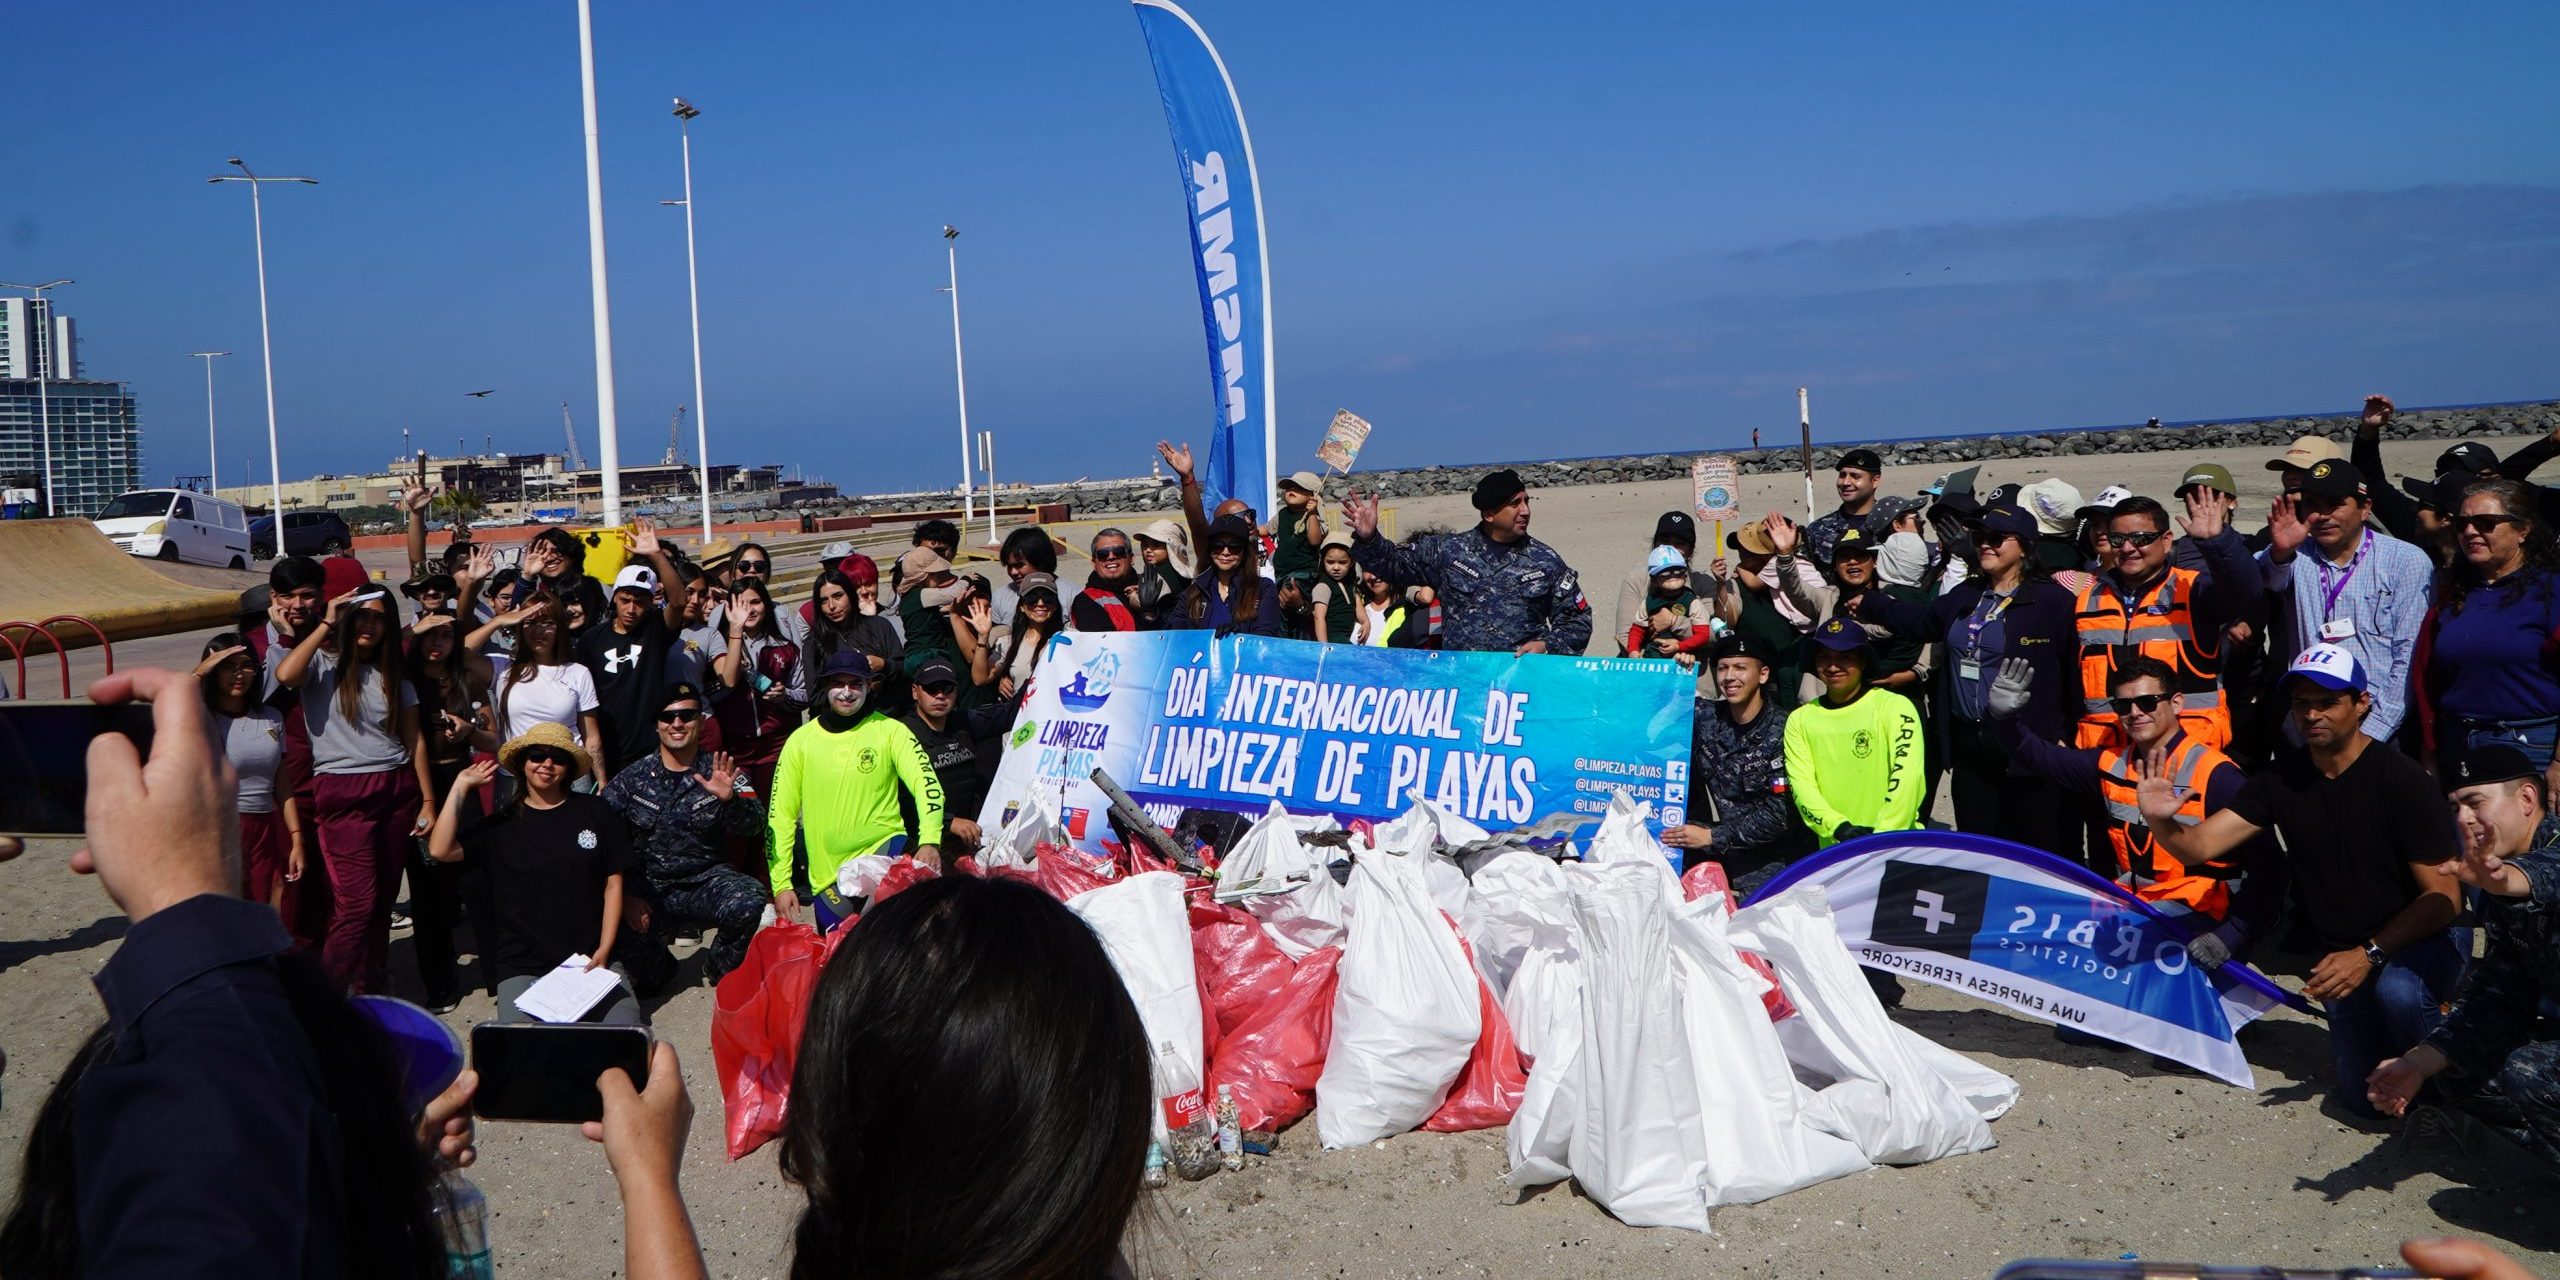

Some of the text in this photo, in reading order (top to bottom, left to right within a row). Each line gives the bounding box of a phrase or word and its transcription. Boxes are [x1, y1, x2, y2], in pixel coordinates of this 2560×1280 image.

[2299, 650, 2338, 665] ati
[1164, 651, 1529, 747] DÍA INTERNACIONAL DE
[1039, 719, 1109, 751] LIMPIEZA
[909, 737, 942, 815] ARMADA
[1036, 748, 1095, 780] PLAYAS
[1140, 725, 1538, 824] LIMPIEZA DE PLAYAS
[1574, 757, 1662, 779] @LIMPIEZA.PLAYAS
